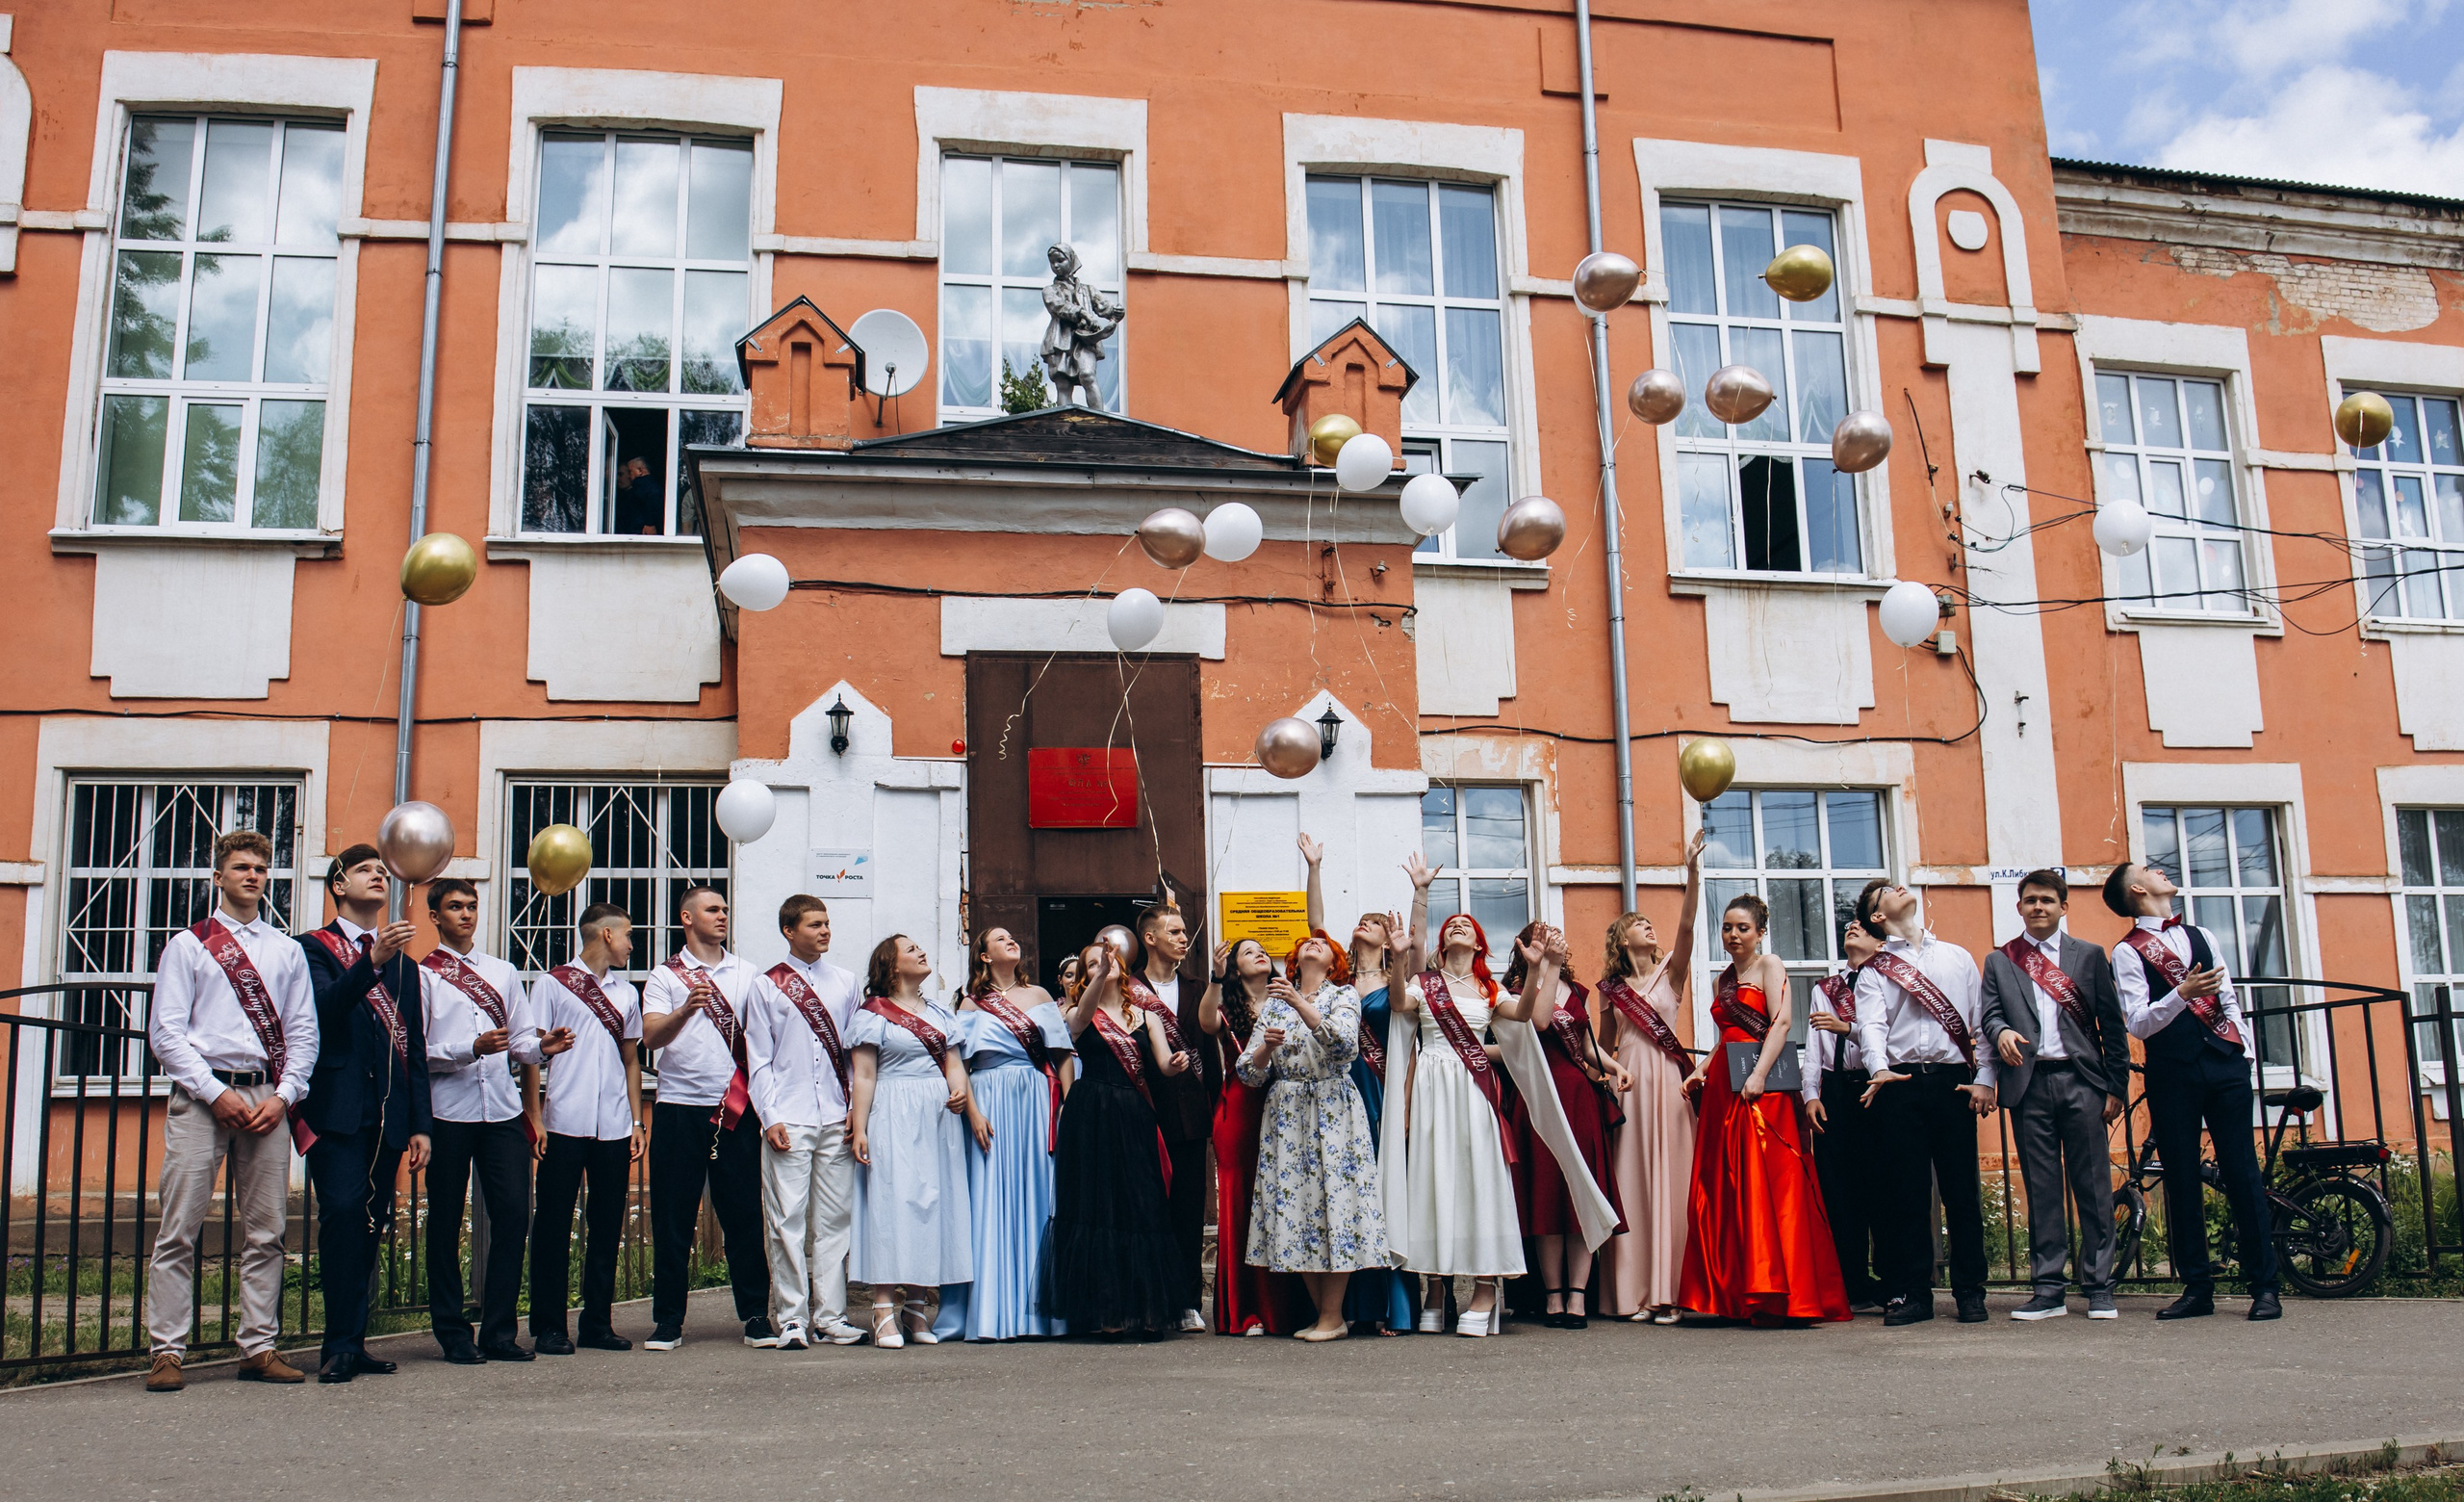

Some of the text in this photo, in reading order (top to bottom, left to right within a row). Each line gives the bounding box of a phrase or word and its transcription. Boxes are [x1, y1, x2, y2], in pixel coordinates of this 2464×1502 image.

[1990, 868, 2028, 880] ул.К.Либк
[236, 969, 275, 1043] Выпускник
[367, 987, 399, 1027] пускник
[462, 973, 507, 1027] Выпускни
[1892, 963, 1945, 1012] Выпускник
[2165, 960, 2216, 1017] Выкник
[1434, 992, 1471, 1048] Выпускница
[1464, 1045, 1491, 1072] 2025
[1612, 983, 1659, 1031] Выпускница
[1655, 1025, 1678, 1050] 2025
